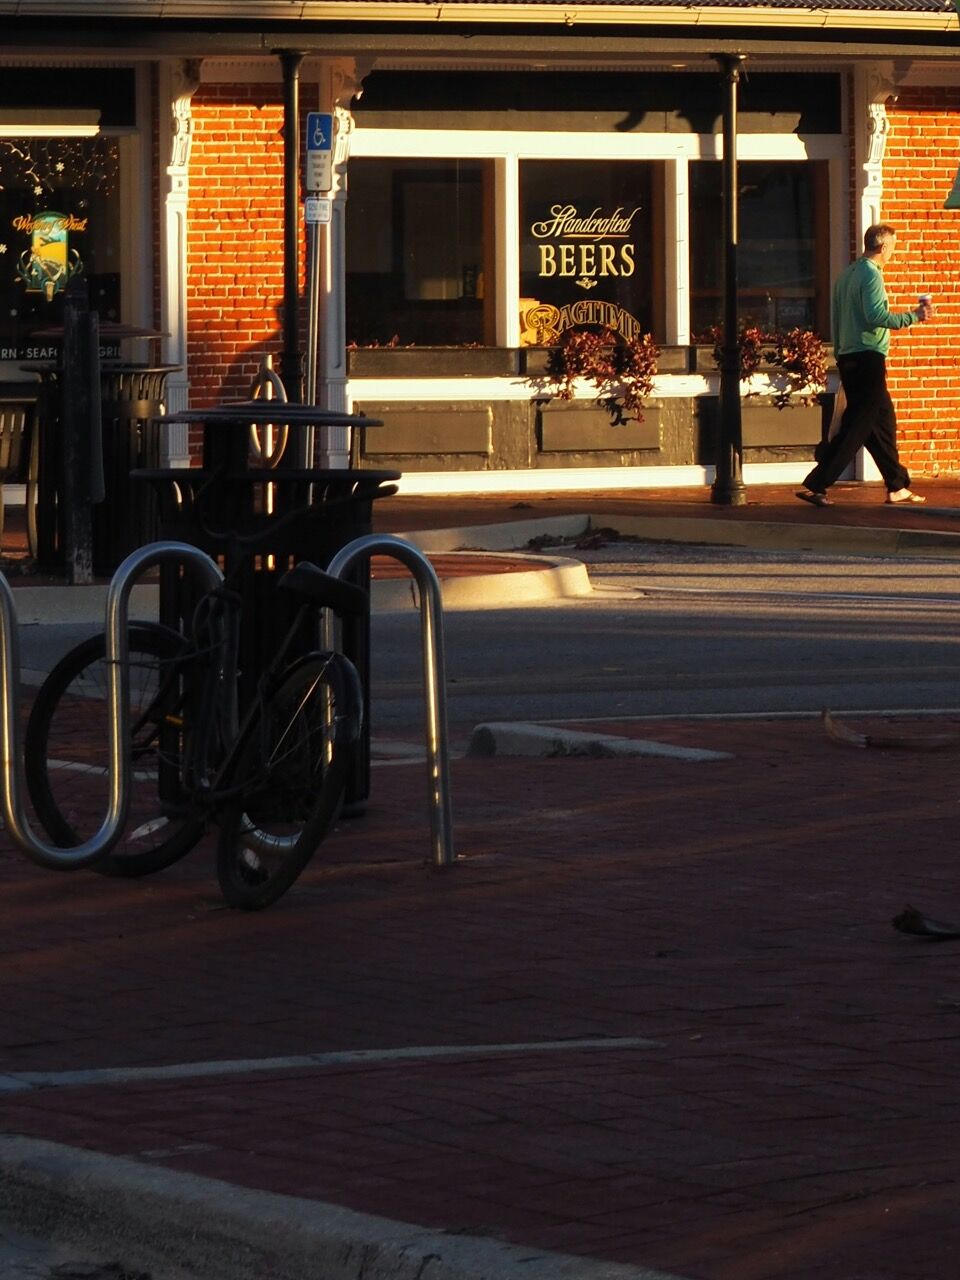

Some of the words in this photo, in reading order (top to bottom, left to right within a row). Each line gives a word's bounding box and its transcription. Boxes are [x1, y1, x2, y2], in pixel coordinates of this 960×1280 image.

[531, 205, 641, 241] Handcrafted
[538, 244, 635, 277] BEERS
[26, 347, 57, 359] SEAF
